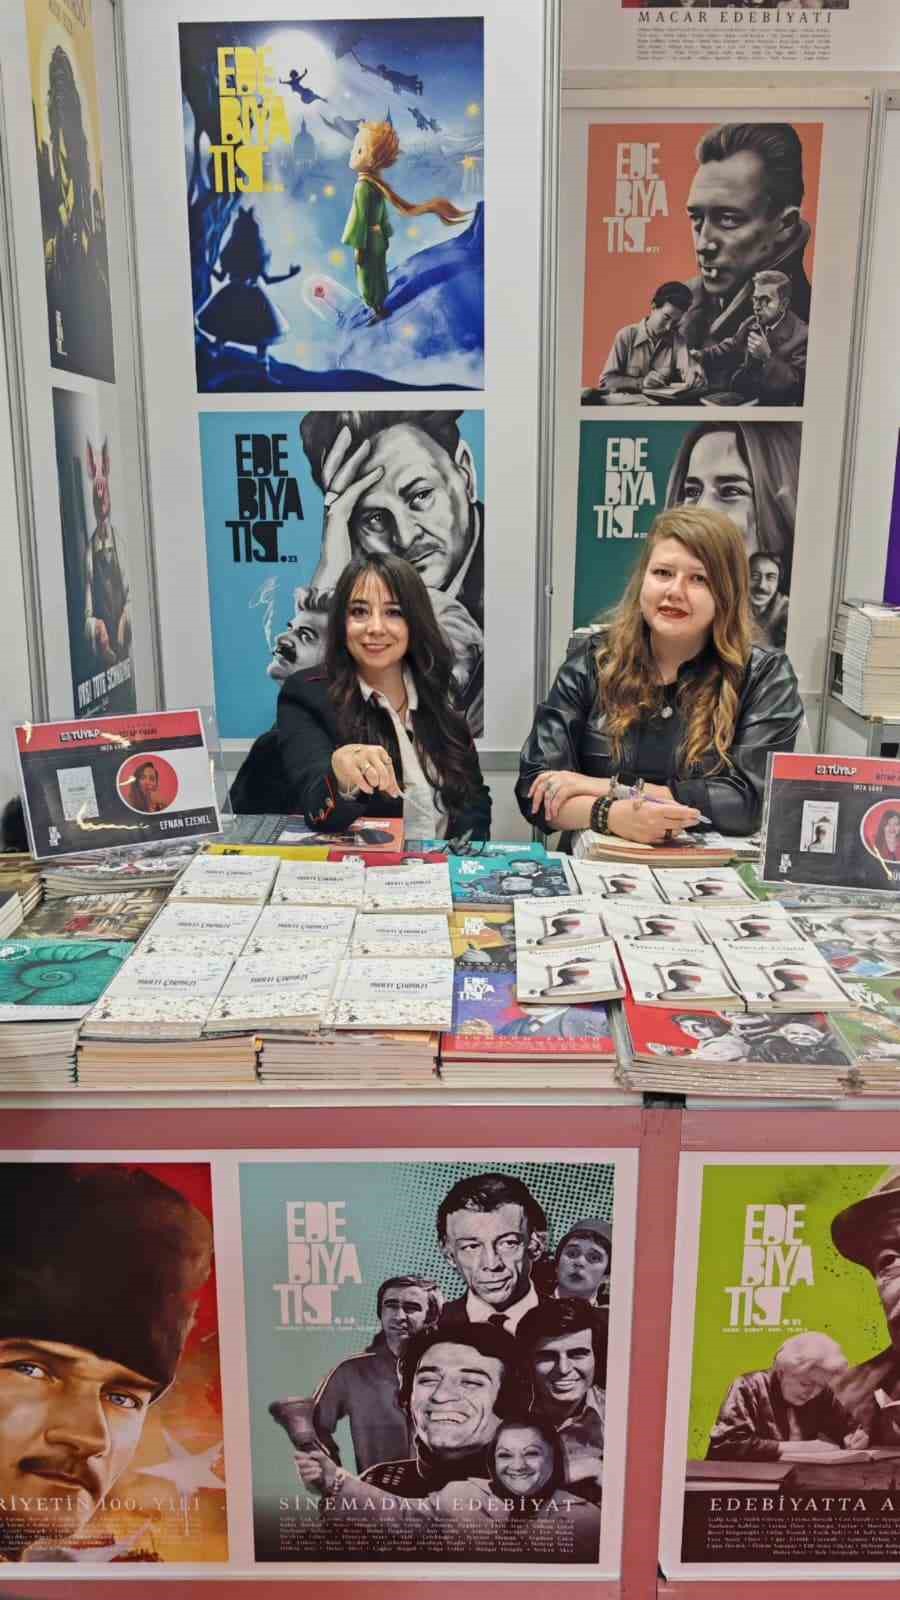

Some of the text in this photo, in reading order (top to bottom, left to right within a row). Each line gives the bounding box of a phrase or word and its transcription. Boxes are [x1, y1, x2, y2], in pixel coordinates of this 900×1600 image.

[638, 9, 832, 23] MACAR EDEBİYATI
[235, 433, 288, 477] EDE
[606, 438, 648, 471] EDE
[72, 728, 100, 740] TÜYAP
[828, 764, 857, 776] TÜYAP
[160, 815, 211, 831] EFNAN EZENEL
[286, 1201, 346, 1242] EDE
[744, 1204, 806, 1245] EDE
[155, 1496, 201, 1511] YILI
[279, 1496, 576, 1511] SİNEMADAKİ EDEBİYAT
[710, 1495, 867, 1512] EDEBİYATTA
